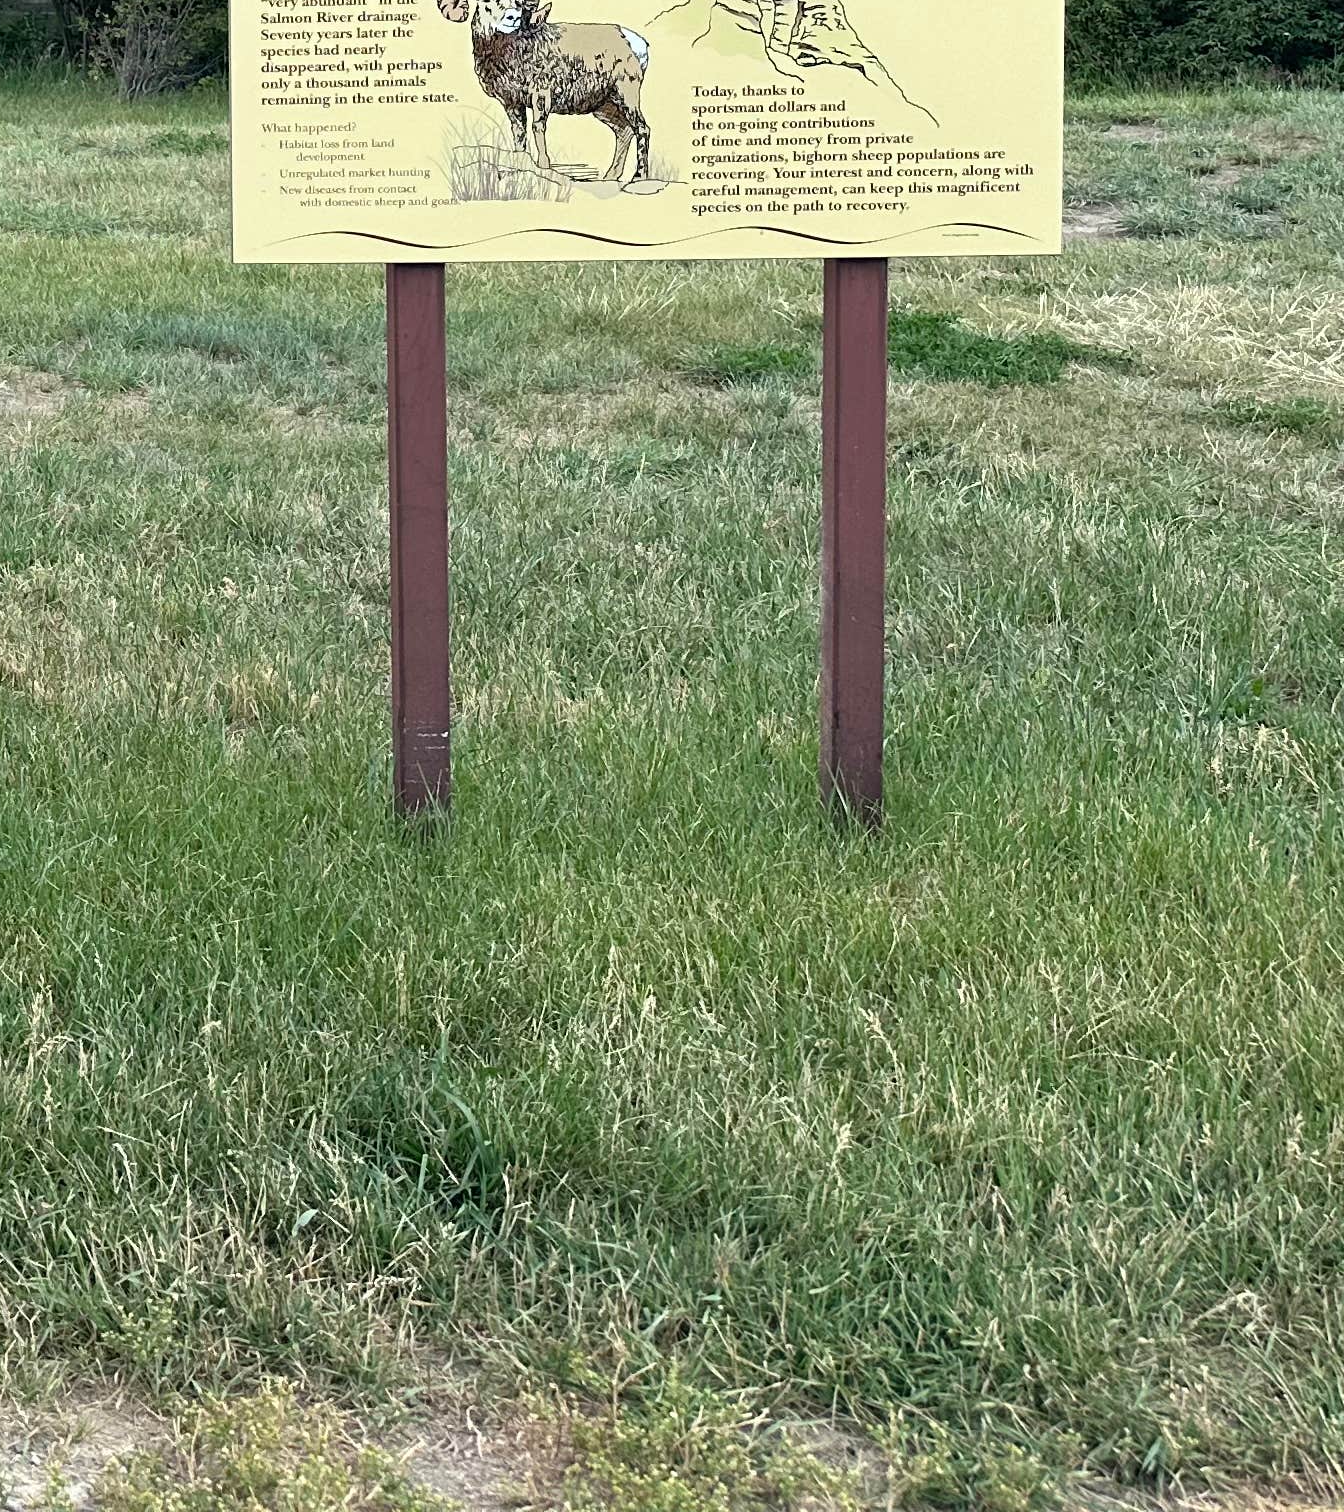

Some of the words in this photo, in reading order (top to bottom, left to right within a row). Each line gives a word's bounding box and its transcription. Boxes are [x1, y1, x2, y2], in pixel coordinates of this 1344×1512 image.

[261, 13, 311, 24] Salmon
[317, 12, 353, 22] River
[261, 30, 312, 42] Seventy
[317, 31, 352, 43] years
[357, 28, 388, 38] later
[393, 27, 413, 37] the
[261, 49, 310, 60] species
[315, 44, 339, 55] had
[345, 44, 385, 57] nearly
[261, 61, 349, 76] disappeared,
[354, 60, 382, 71] with
[388, 59, 442, 74] perhaps
[262, 78, 290, 91] only
[306, 76, 369, 88] thousand
[374, 76, 426, 87] animals
[693, 86, 737, 98] Today,
[743, 85, 787, 96] thanks
[792, 86, 804, 95] to
[262, 97, 331, 108] remaining
[336, 94, 347, 104] in
[353, 93, 373, 104] the
[378, 95, 418, 103] entire
[423, 94, 458, 102] state.
[692, 104, 764, 117] sportsman
[769, 101, 816, 112] dollars
[821, 100, 845, 111] and
[262, 123, 291, 133] What
[295, 122, 356, 135] happened?
[692, 119, 713, 130] the
[718, 121, 778, 133] on-going
[782, 117, 874, 128] contributions
[280, 140, 317, 149] Habitat
[321, 140, 340, 148] loss
[343, 140, 368, 148] from
[372, 139, 394, 147] land
[692, 136, 708, 146] of
[712, 136, 741, 146] time
[746, 135, 771, 146] and
[777, 138, 822, 148] money
[828, 134, 861, 144] from
[866, 135, 913, 148] private
[296, 152, 365, 164] development
[692, 154, 788, 166] organizations,
[793, 151, 847, 165] bighorn
[852, 150, 892, 164] sheep
[897, 149, 980, 164] populations
[280, 168, 345, 180] Unregulated
[349, 168, 385, 177] market
[389, 168, 430, 179] hunting
[773, 168, 806, 178] Your
[811, 169, 862, 178] interest
[867, 166, 893, 177] and
[897, 169, 957, 177] concern,
[962, 165, 1001, 179] along
[1005, 164, 1033, 175] with
[280, 186, 301, 194] New
[305, 186, 346, 194] diseases
[350, 185, 374, 193] from
[378, 186, 416, 194] contact
[692, 185, 740, 196] careful
[745, 186, 837, 198] management,
[870, 183, 904, 197] keep
[909, 182, 932, 193] this
[937, 181, 1020, 196] magnificent
[300, 198, 322, 207] with
[325, 198, 371, 206] domestic
[375, 198, 406, 208] sheep
[409, 196, 428, 205] and
[692, 205, 741, 216] species
[768, 201, 788, 212] the
[794, 200, 823, 215] path
[829, 202, 842, 211] to
